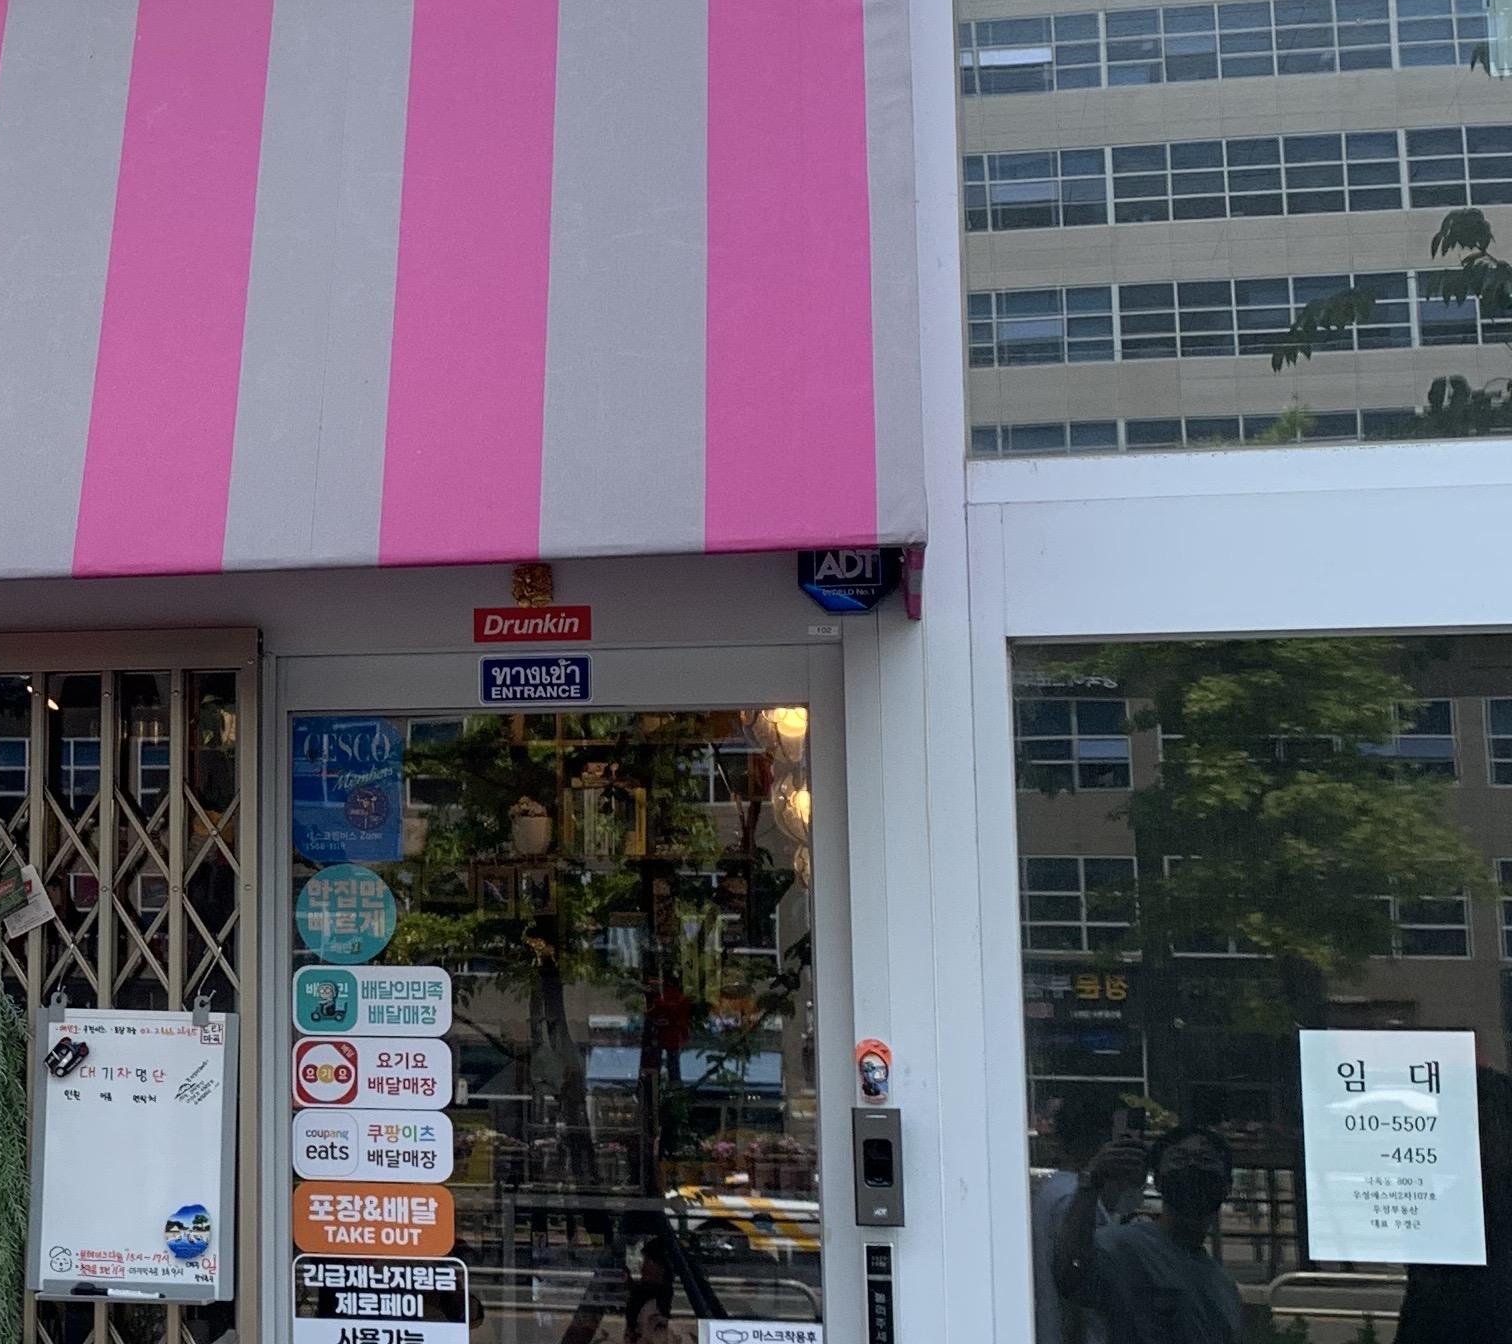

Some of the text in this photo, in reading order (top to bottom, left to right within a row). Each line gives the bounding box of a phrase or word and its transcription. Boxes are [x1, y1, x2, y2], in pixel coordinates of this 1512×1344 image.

[815, 550, 880, 579] ADT
[483, 612, 580, 635] Drunkin
[491, 658, 580, 685] ทางเข้า
[491, 685, 581, 699] ENTRANCE
[303, 733, 391, 762] CESCO
[306, 911, 386, 939] 빠르게
[360, 980, 444, 1000] 배달의민족
[368, 1004, 437, 1025] 배달매장
[376, 1052, 428, 1069] 요기요
[368, 1076, 438, 1097] 배달매장
[305, 1124, 436, 1143] coupang 쿠팡이츠
[1345, 1114, 1437, 1132] 010-5507
[305, 1141, 438, 1170] eats 배달매장
[308, 1194, 439, 1225] 포장&배달
[324, 1225, 422, 1246] TAKE OUT
[303, 1263, 457, 1292] 긴급재난지원금
[335, 1292, 424, 1318] 제로페이
